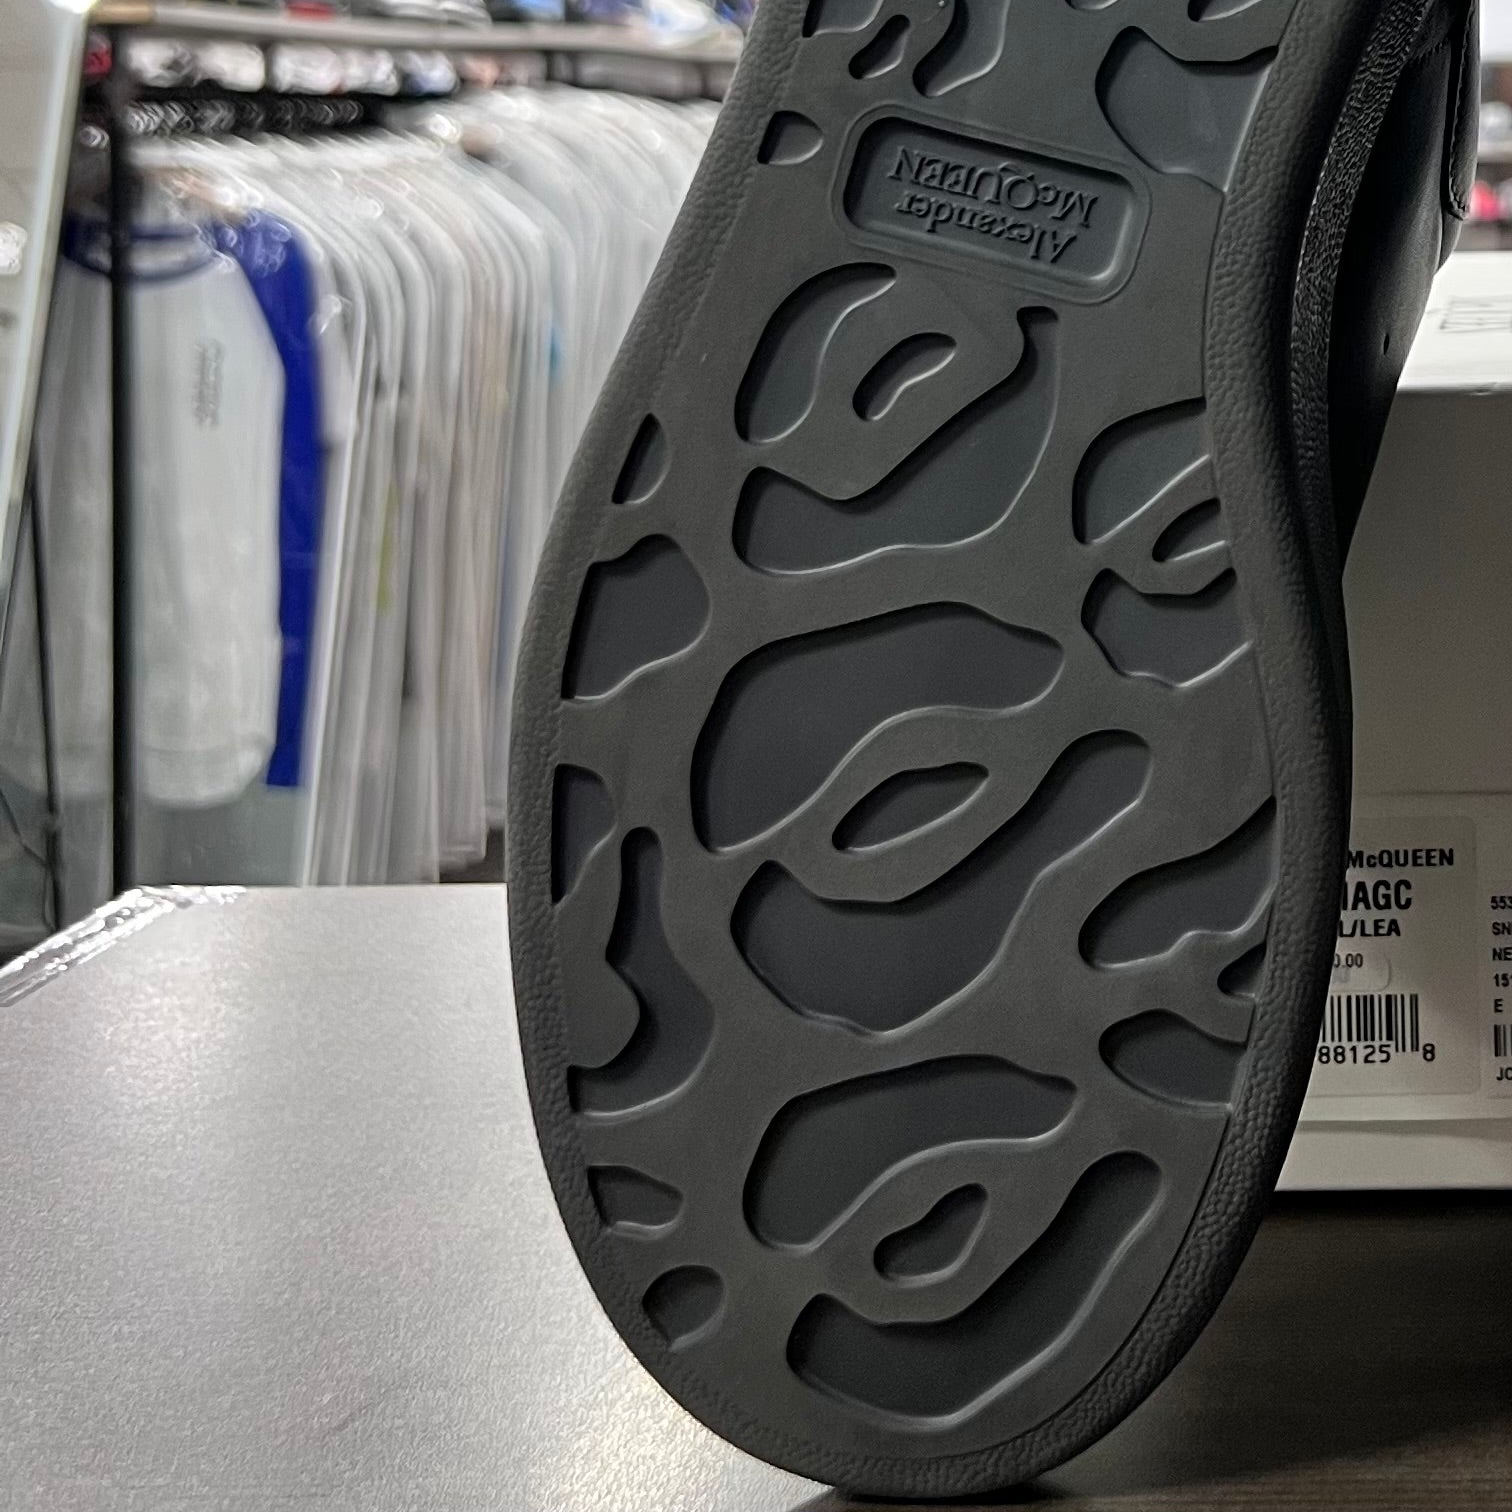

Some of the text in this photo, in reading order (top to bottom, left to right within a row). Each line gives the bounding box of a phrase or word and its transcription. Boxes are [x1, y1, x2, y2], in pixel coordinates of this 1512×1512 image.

[895, 191, 1077, 263] Alexander
[1348, 848, 1454, 869] McQUEEN
[1493, 998, 1504, 1013] E
[1318, 1043, 1436, 1064] 88125 8
